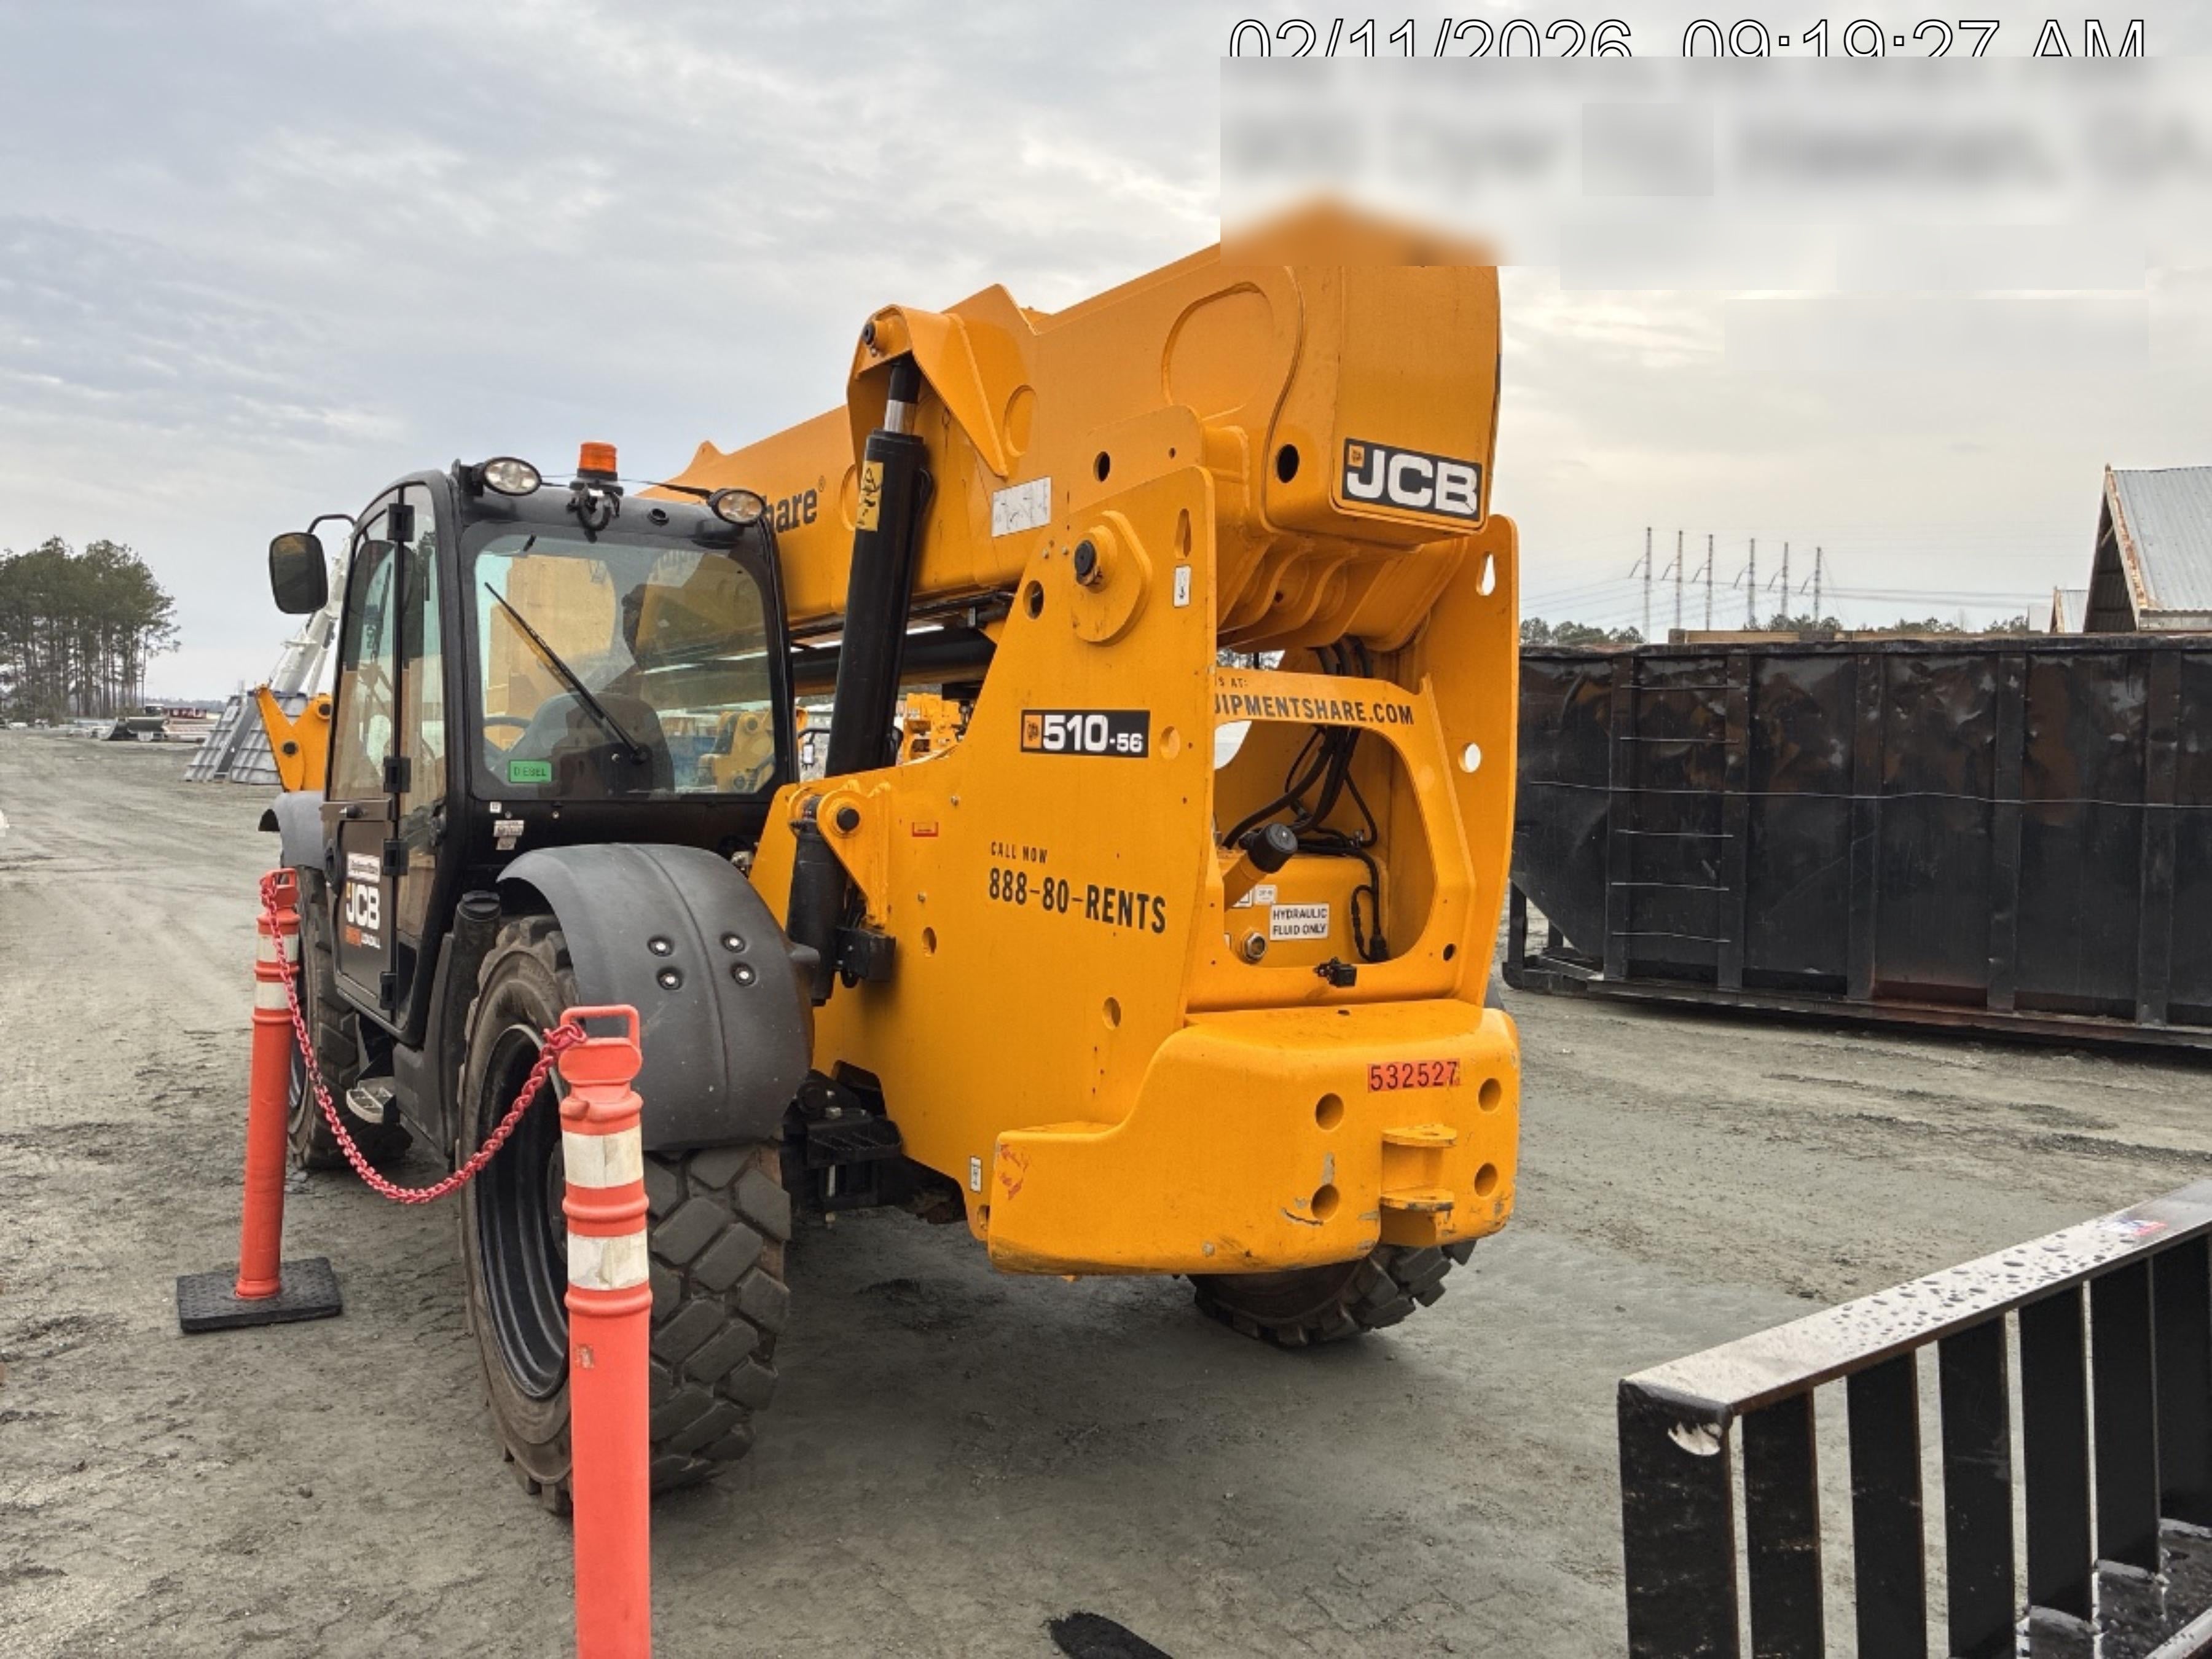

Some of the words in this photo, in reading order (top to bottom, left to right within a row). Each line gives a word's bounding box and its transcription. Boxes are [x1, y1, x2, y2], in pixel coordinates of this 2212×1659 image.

[1347, 449, 1477, 515] JCB
[1042, 714, 1143, 753] 510-56
[514, 766, 546, 777] DESEL
[990, 841, 1017, 860] CALL
[1022, 845, 1048, 865] NOW
[345, 881, 380, 930] JCB
[989, 867, 1166, 934] 888-80-RENTS
[1273, 908, 1328, 920] HYDRAULIC
[1273, 925, 1300, 935] FLUID
[1302, 923, 1327, 935] ONLY
[1370, 1061, 1457, 1091] 532527
